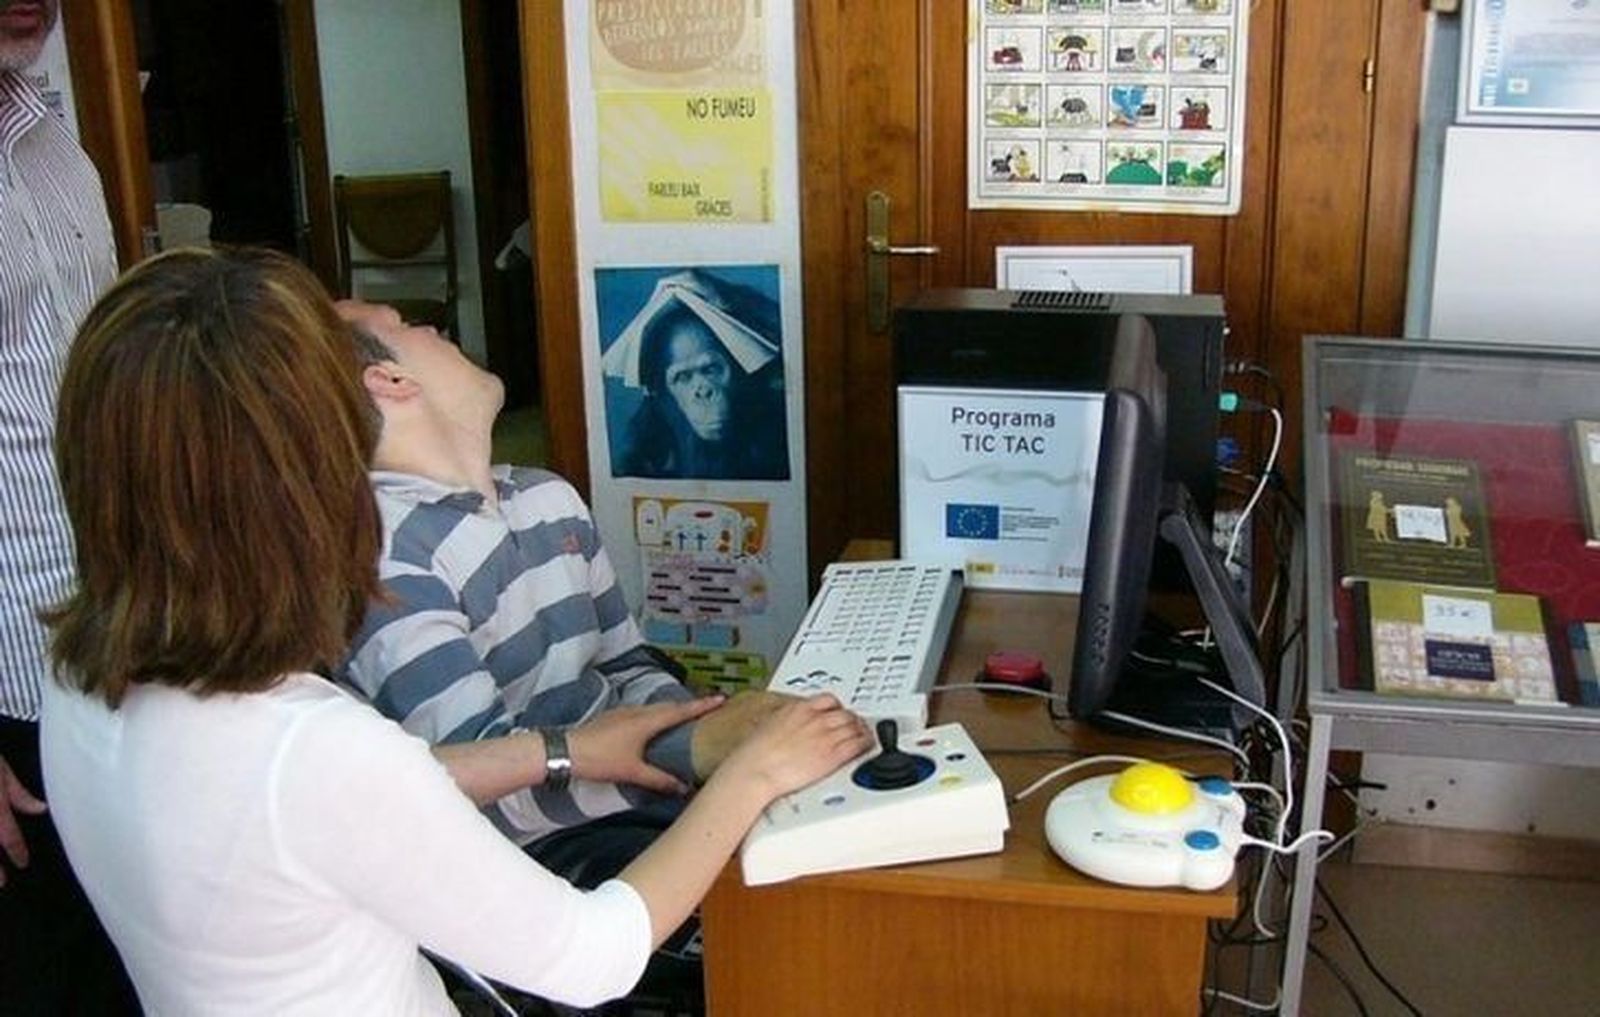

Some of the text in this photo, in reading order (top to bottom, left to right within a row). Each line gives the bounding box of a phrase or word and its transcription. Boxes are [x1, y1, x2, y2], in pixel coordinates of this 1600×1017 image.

[686, 96, 756, 119] NO FUMEU
[951, 406, 1056, 429] Programa
[961, 434, 1045, 455] TIC TAC
